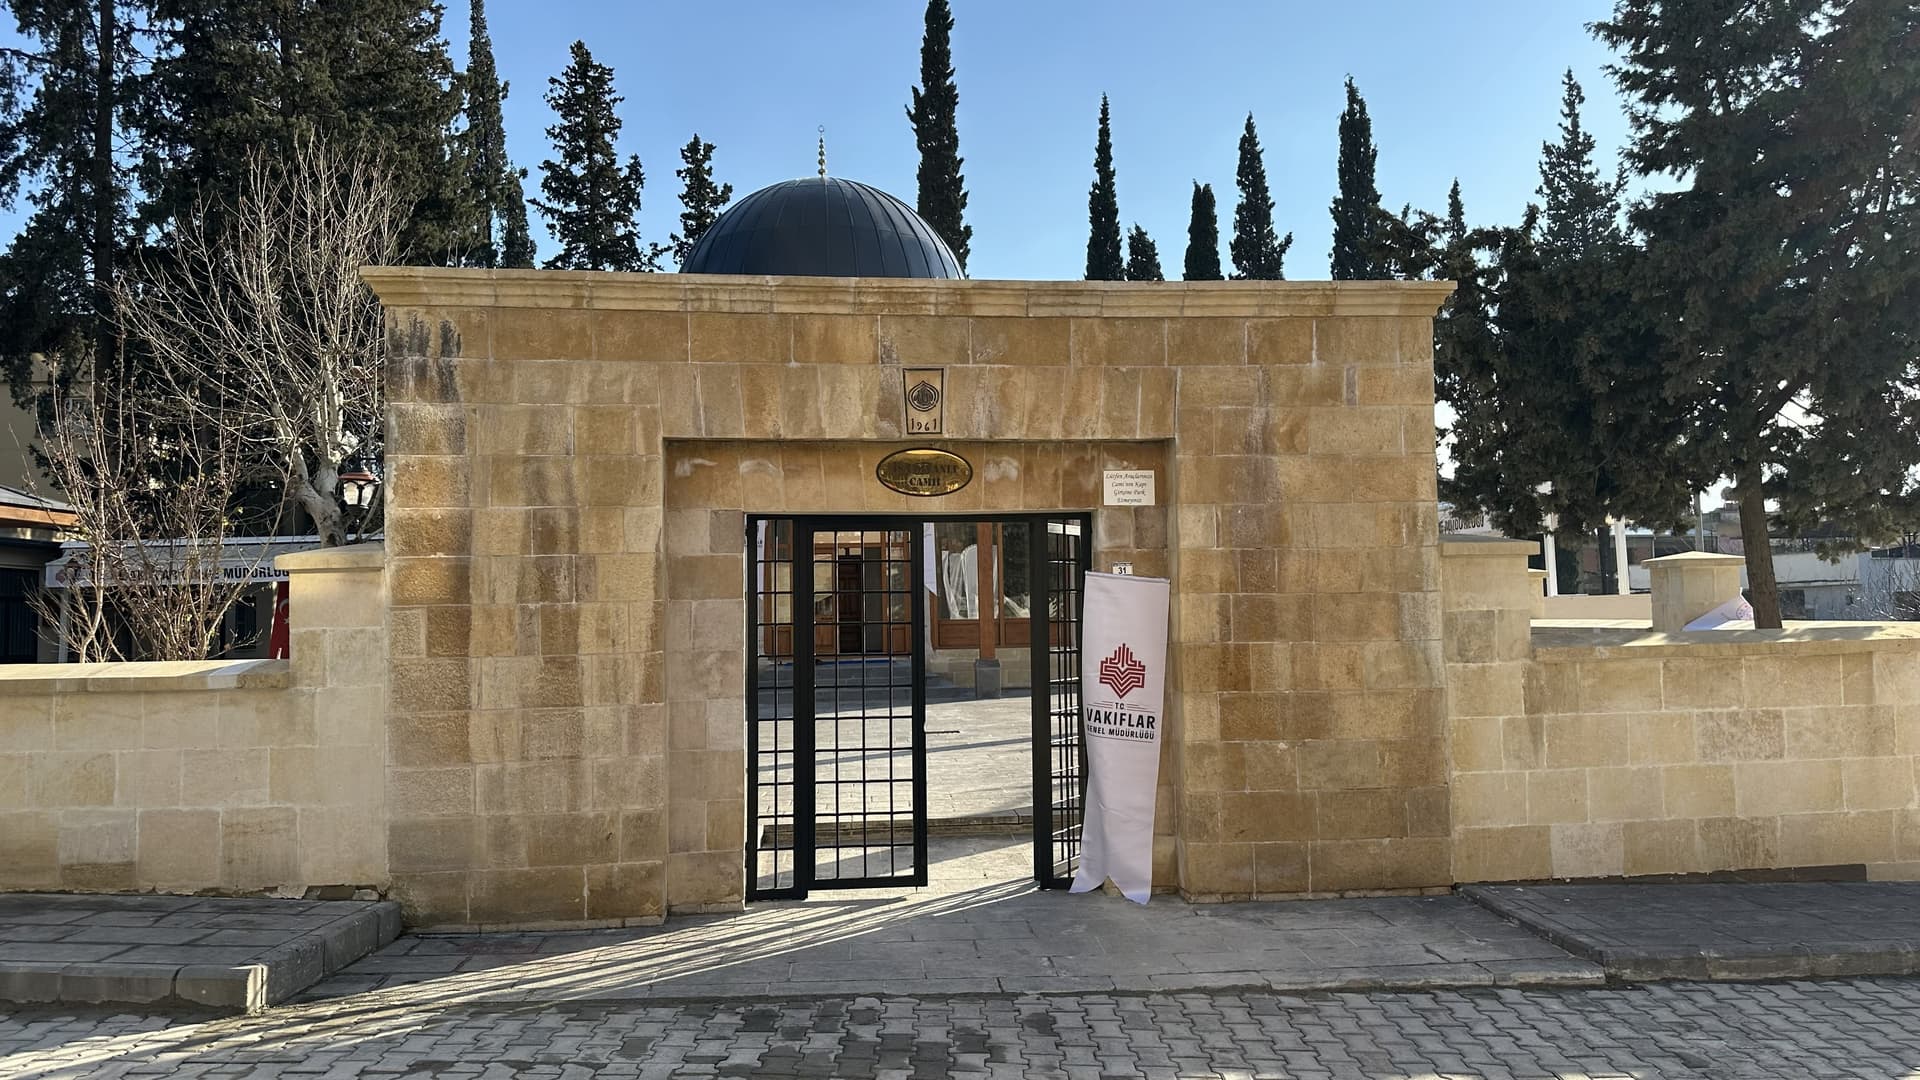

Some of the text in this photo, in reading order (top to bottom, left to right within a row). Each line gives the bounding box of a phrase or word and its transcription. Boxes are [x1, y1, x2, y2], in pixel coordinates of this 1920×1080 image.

[911, 417, 937, 431] 1961
[1118, 566, 1126, 574] 31
[1086, 707, 1156, 729] VAKIFLAR
